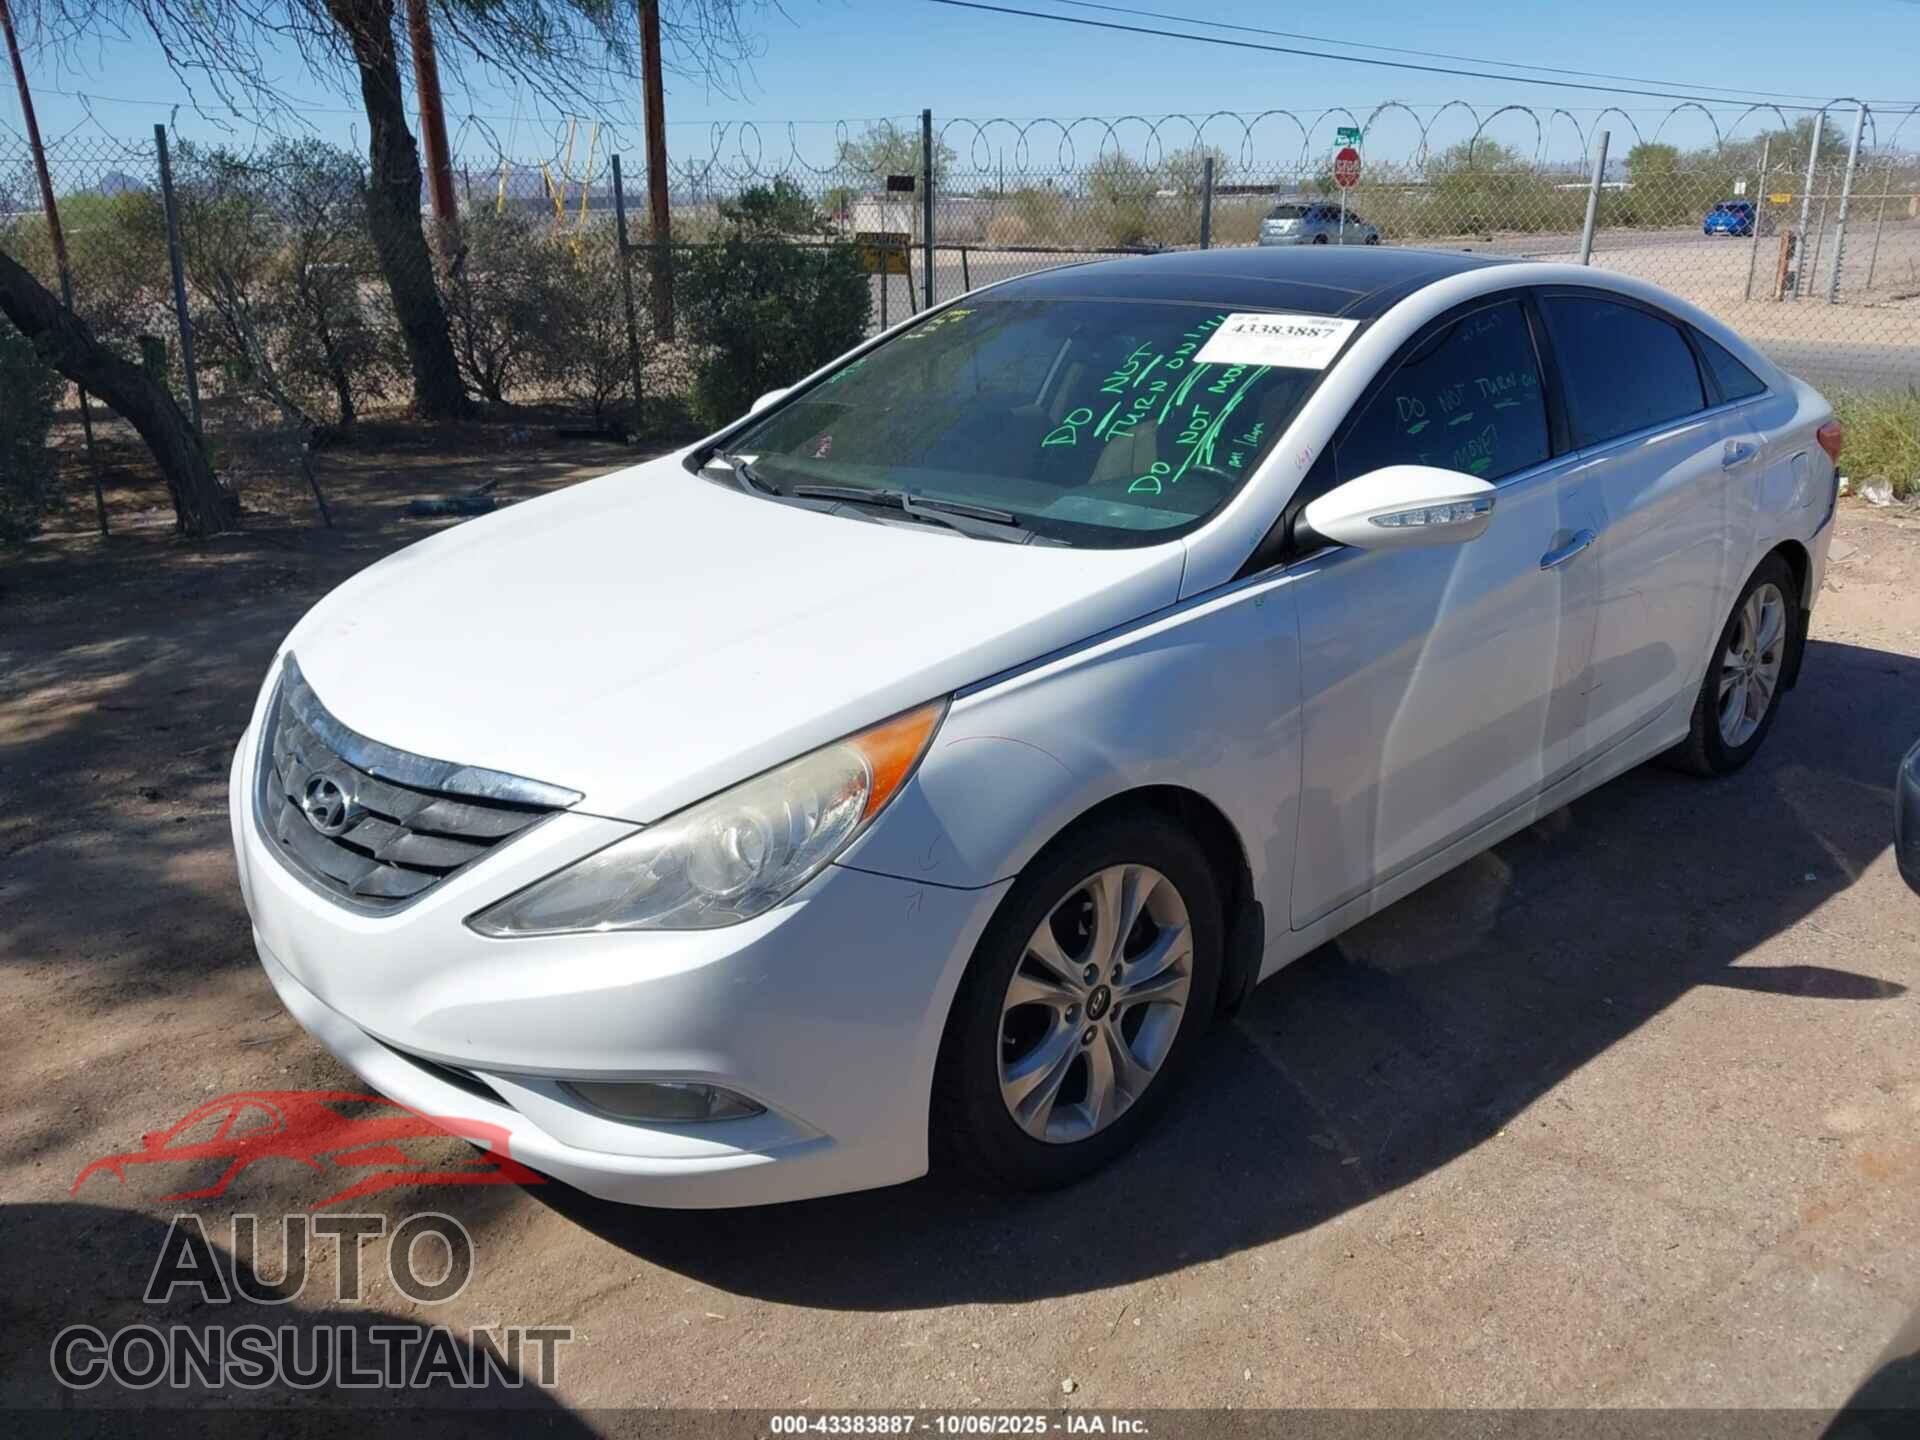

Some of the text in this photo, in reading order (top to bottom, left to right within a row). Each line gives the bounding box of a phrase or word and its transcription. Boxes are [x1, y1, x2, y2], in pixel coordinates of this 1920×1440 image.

[1231, 323, 1336, 339] 43383887
[1041, 341, 1152, 447] DO NOT
[1105, 381, 1167, 442] TURN
[1128, 462, 1170, 494] DO
[1176, 404, 1210, 444] NOT
